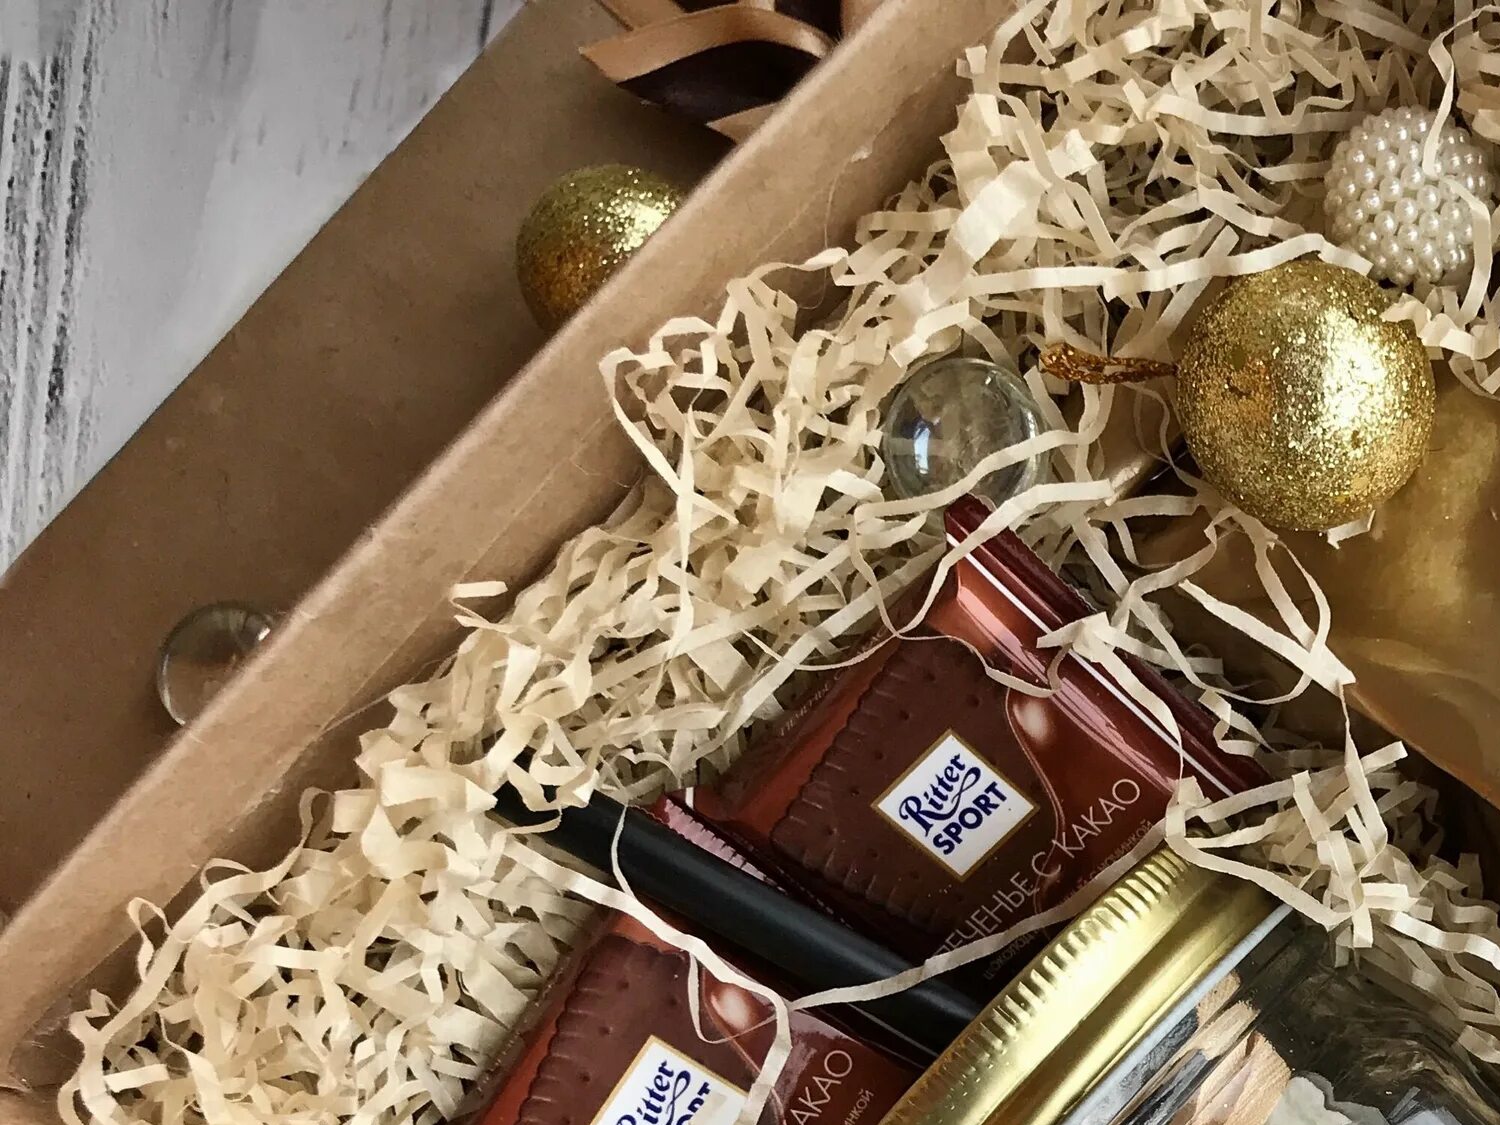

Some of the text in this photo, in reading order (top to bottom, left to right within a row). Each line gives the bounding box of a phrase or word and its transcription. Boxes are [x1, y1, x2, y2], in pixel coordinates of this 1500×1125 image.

[899, 753, 981, 838] Ritter
[932, 781, 1007, 855] SPORT
[1031, 851, 1062, 878] С
[1051, 778, 1141, 859] КАКАО
